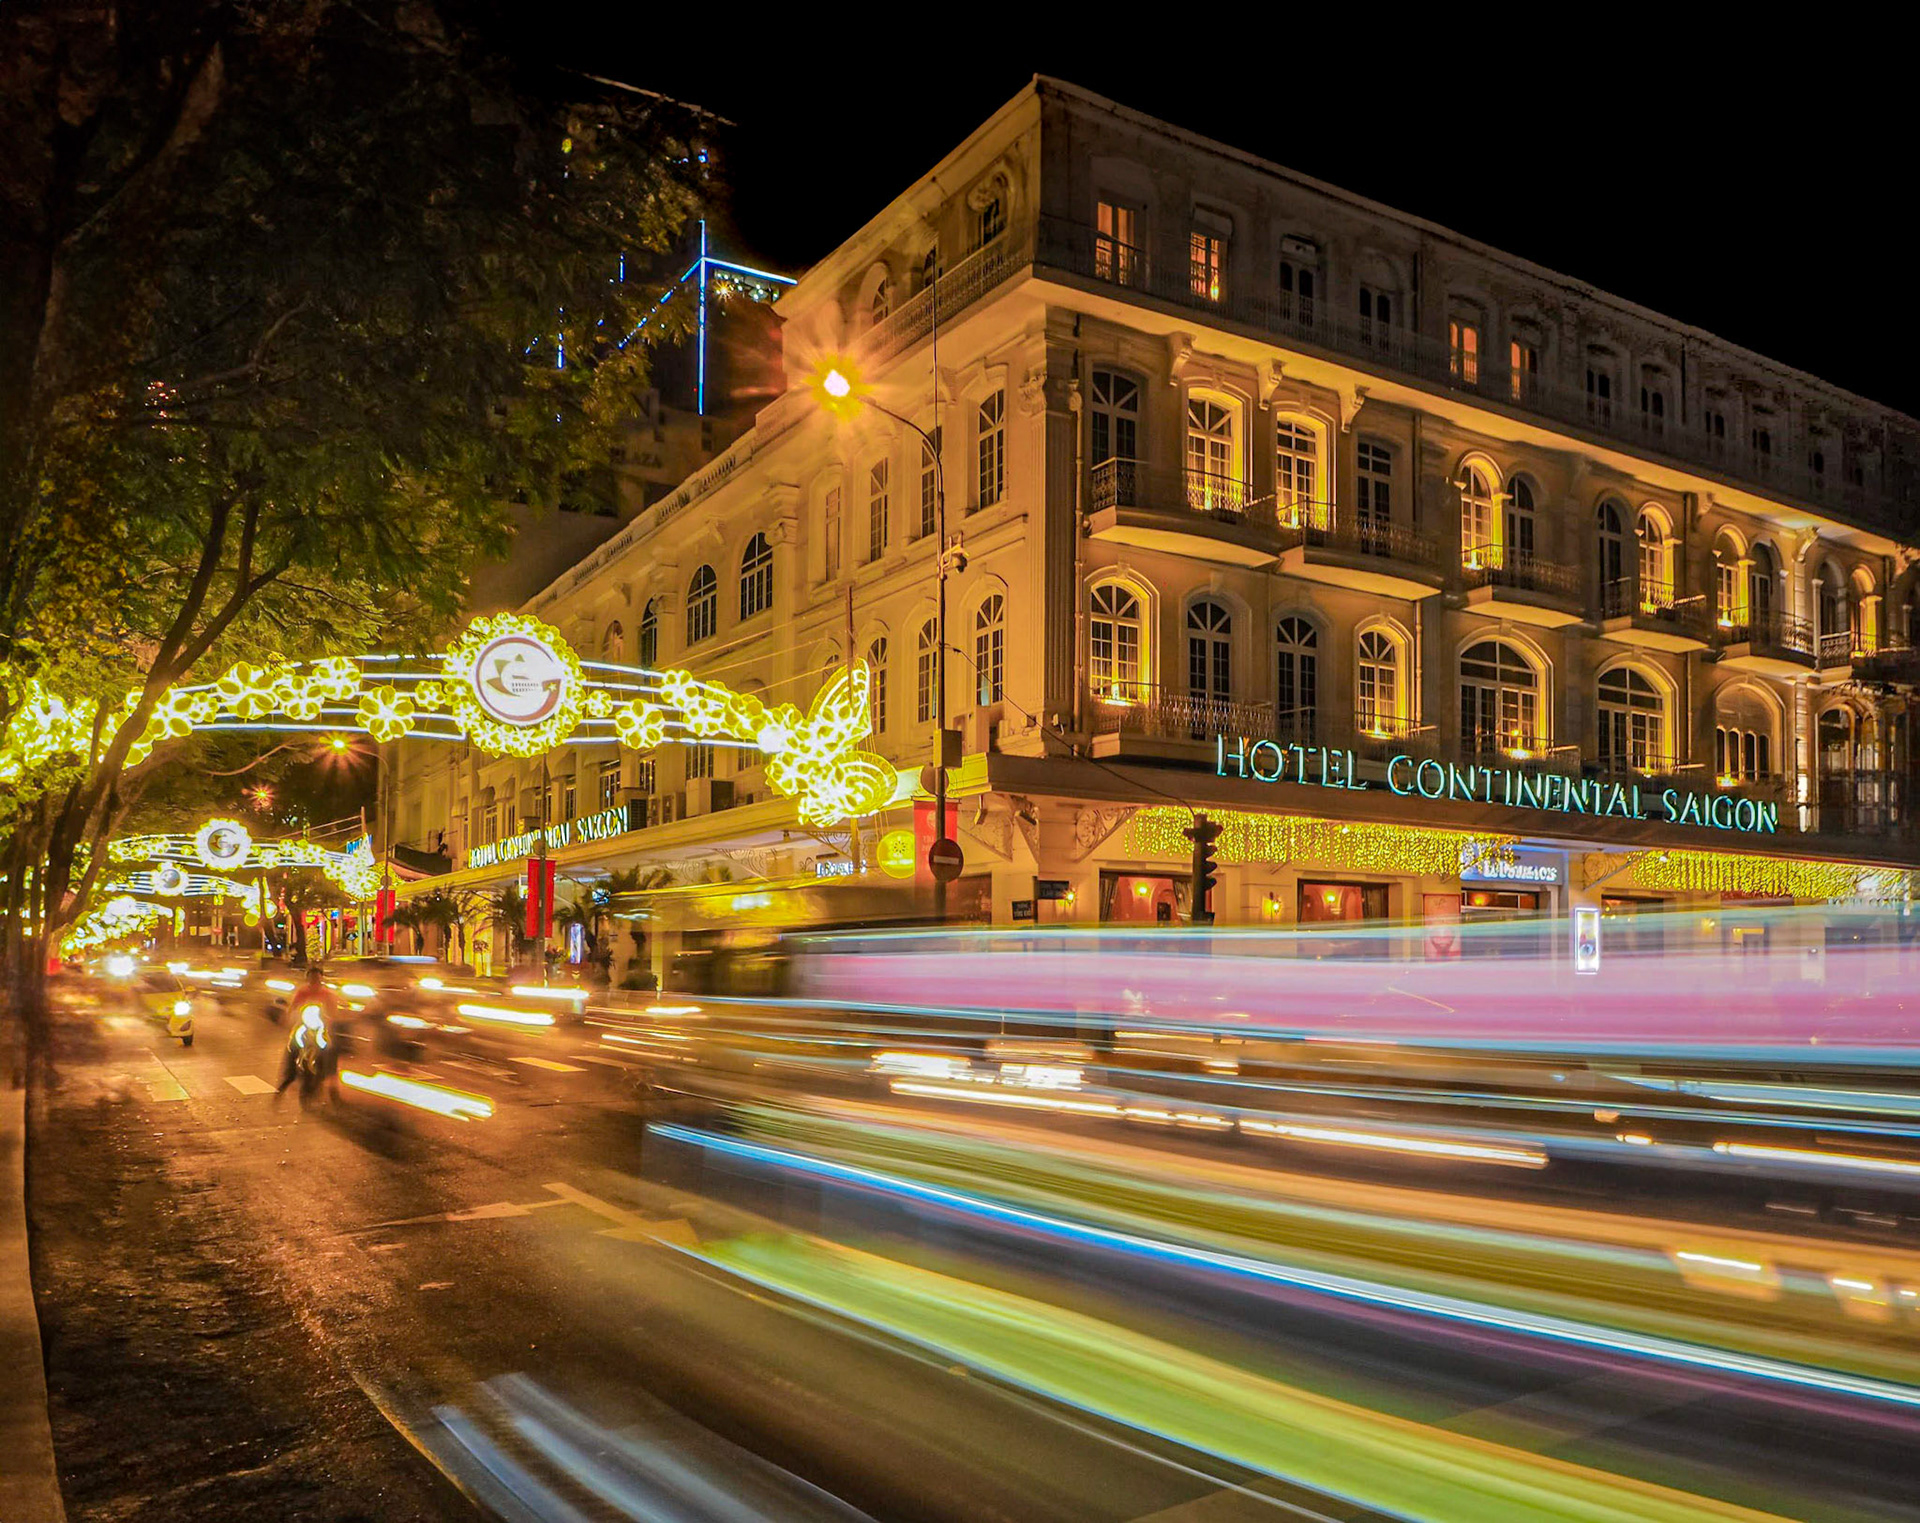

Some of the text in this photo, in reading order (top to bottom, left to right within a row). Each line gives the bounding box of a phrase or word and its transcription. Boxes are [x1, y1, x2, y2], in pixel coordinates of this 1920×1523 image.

[1217, 733, 1779, 834] HOTEL CONTINENTAL SAIGON
